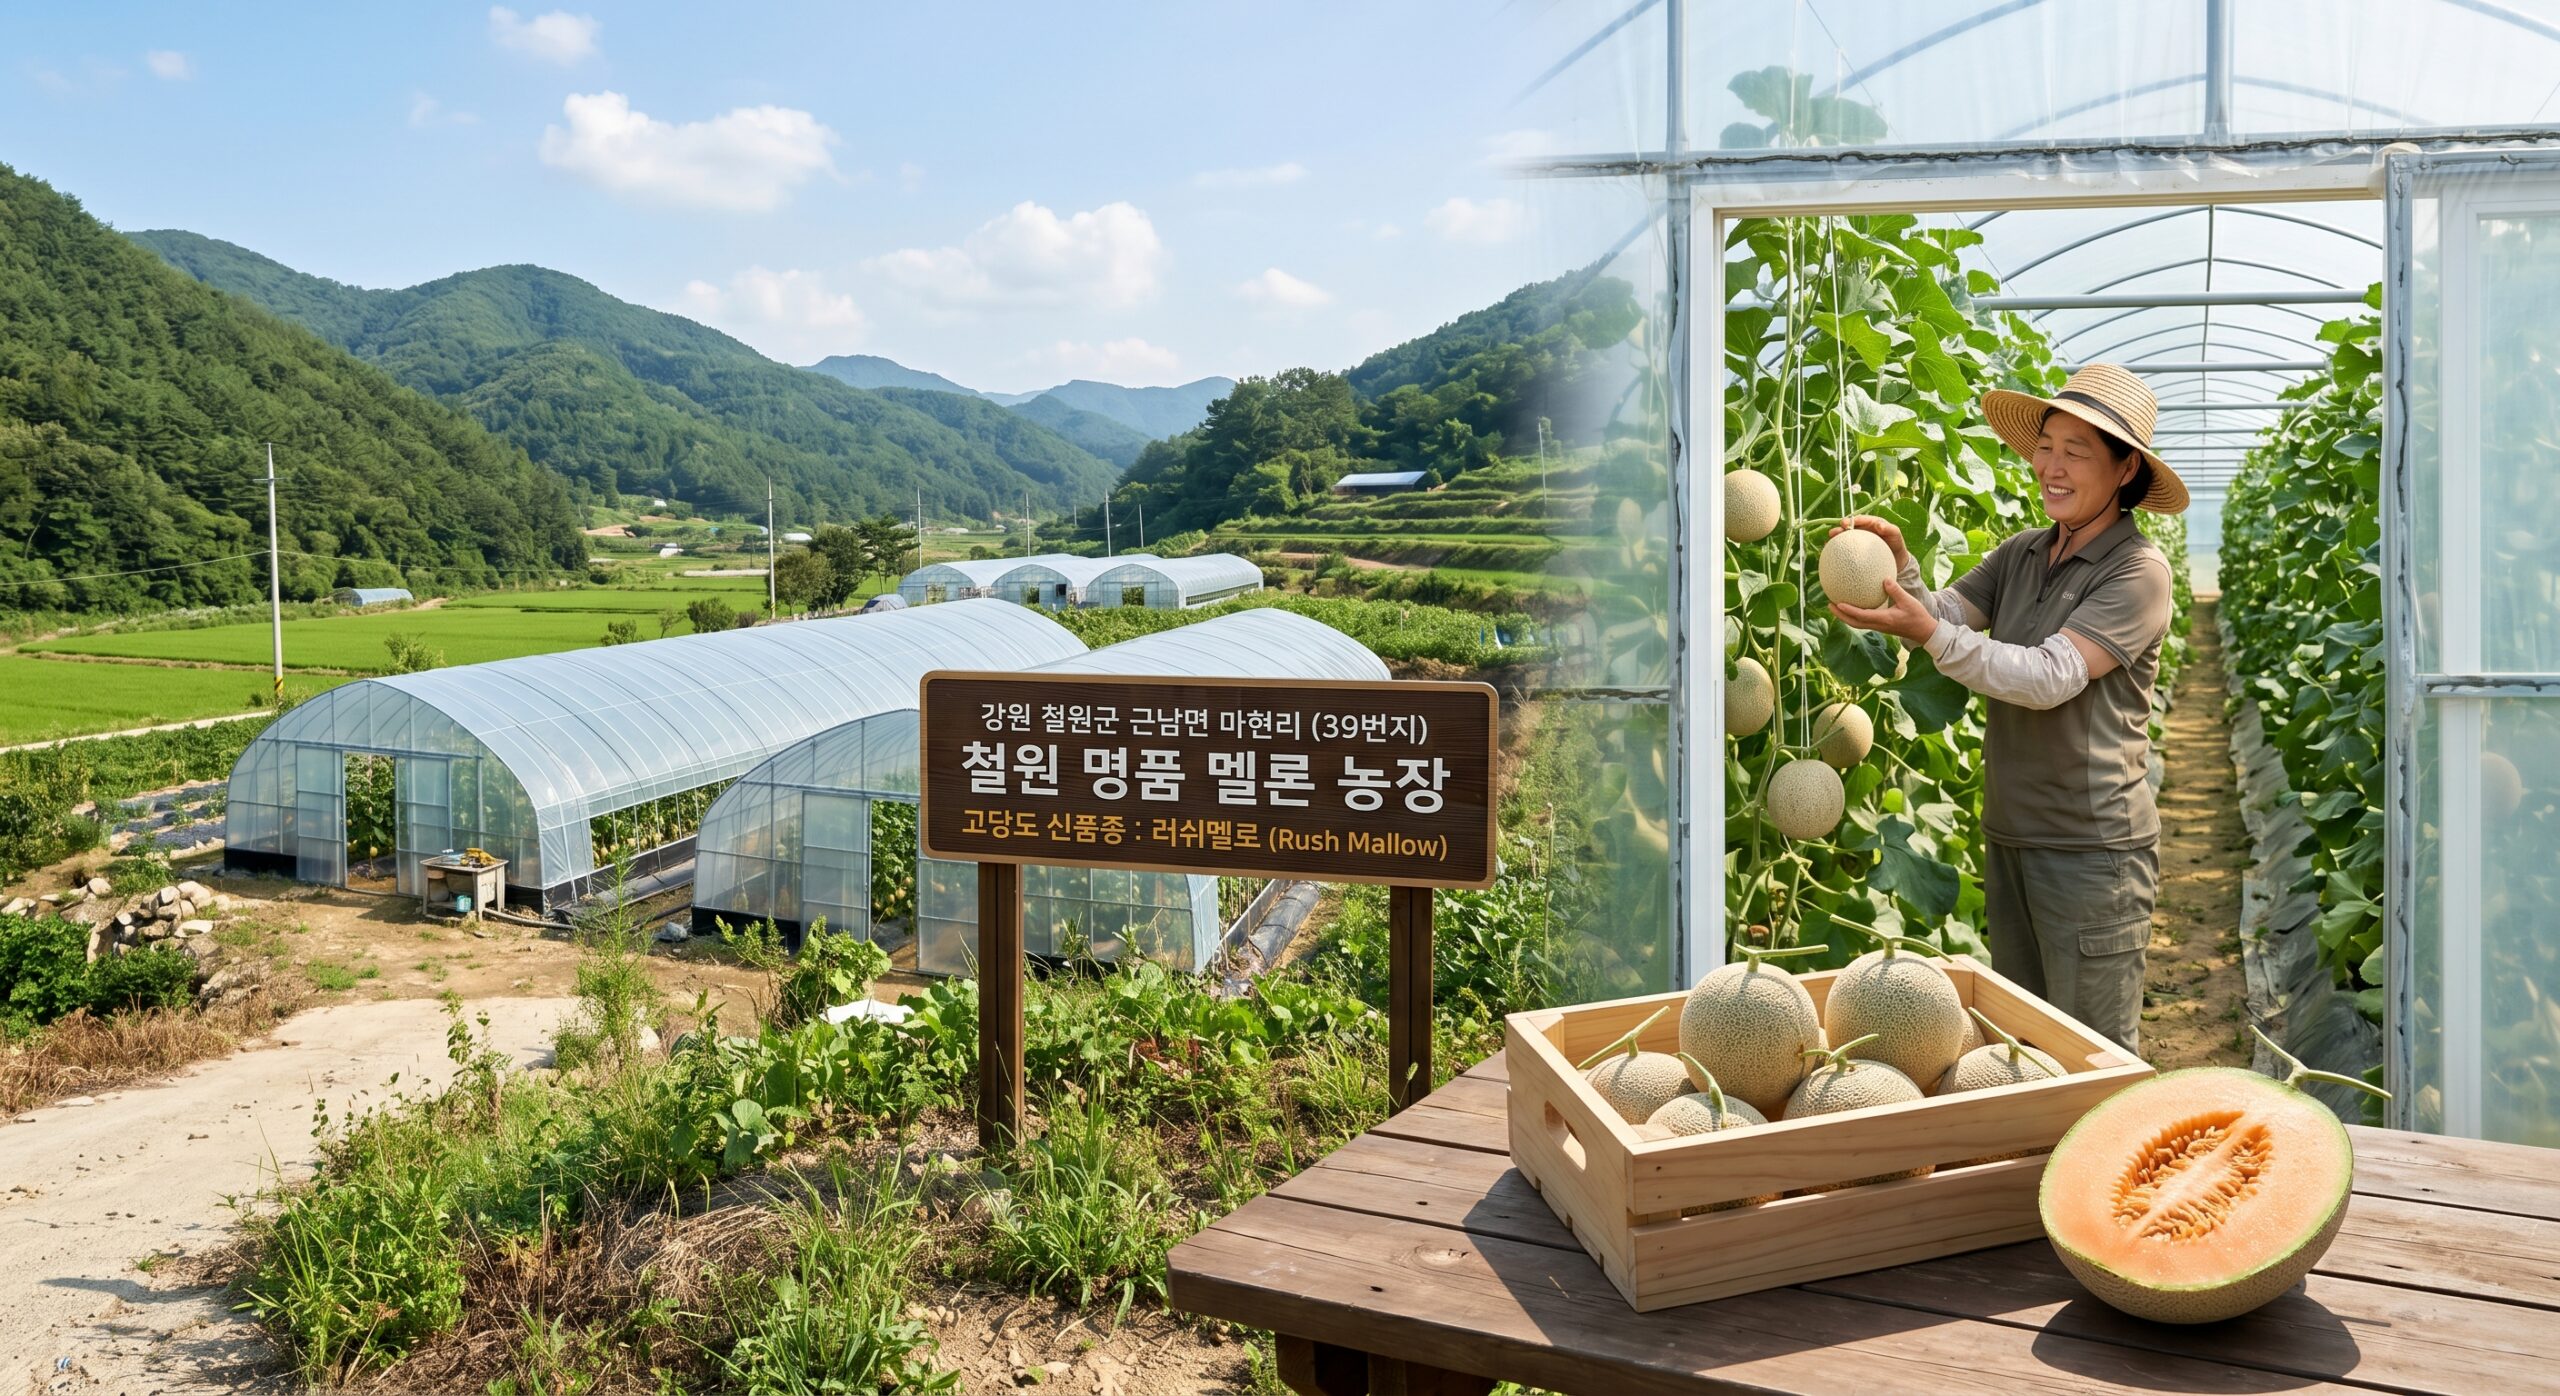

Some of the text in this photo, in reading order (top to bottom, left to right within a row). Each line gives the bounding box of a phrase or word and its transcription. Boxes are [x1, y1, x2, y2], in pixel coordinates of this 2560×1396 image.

[981, 703, 1427, 745] 강원 철원군 근남면 마현리 (39번지)
[962, 741, 1450, 814] 철원 명품 멜론 농장
[961, 809, 1447, 862] 고당도 신품종 : 러쉬멜로 (Rush Mallow)
